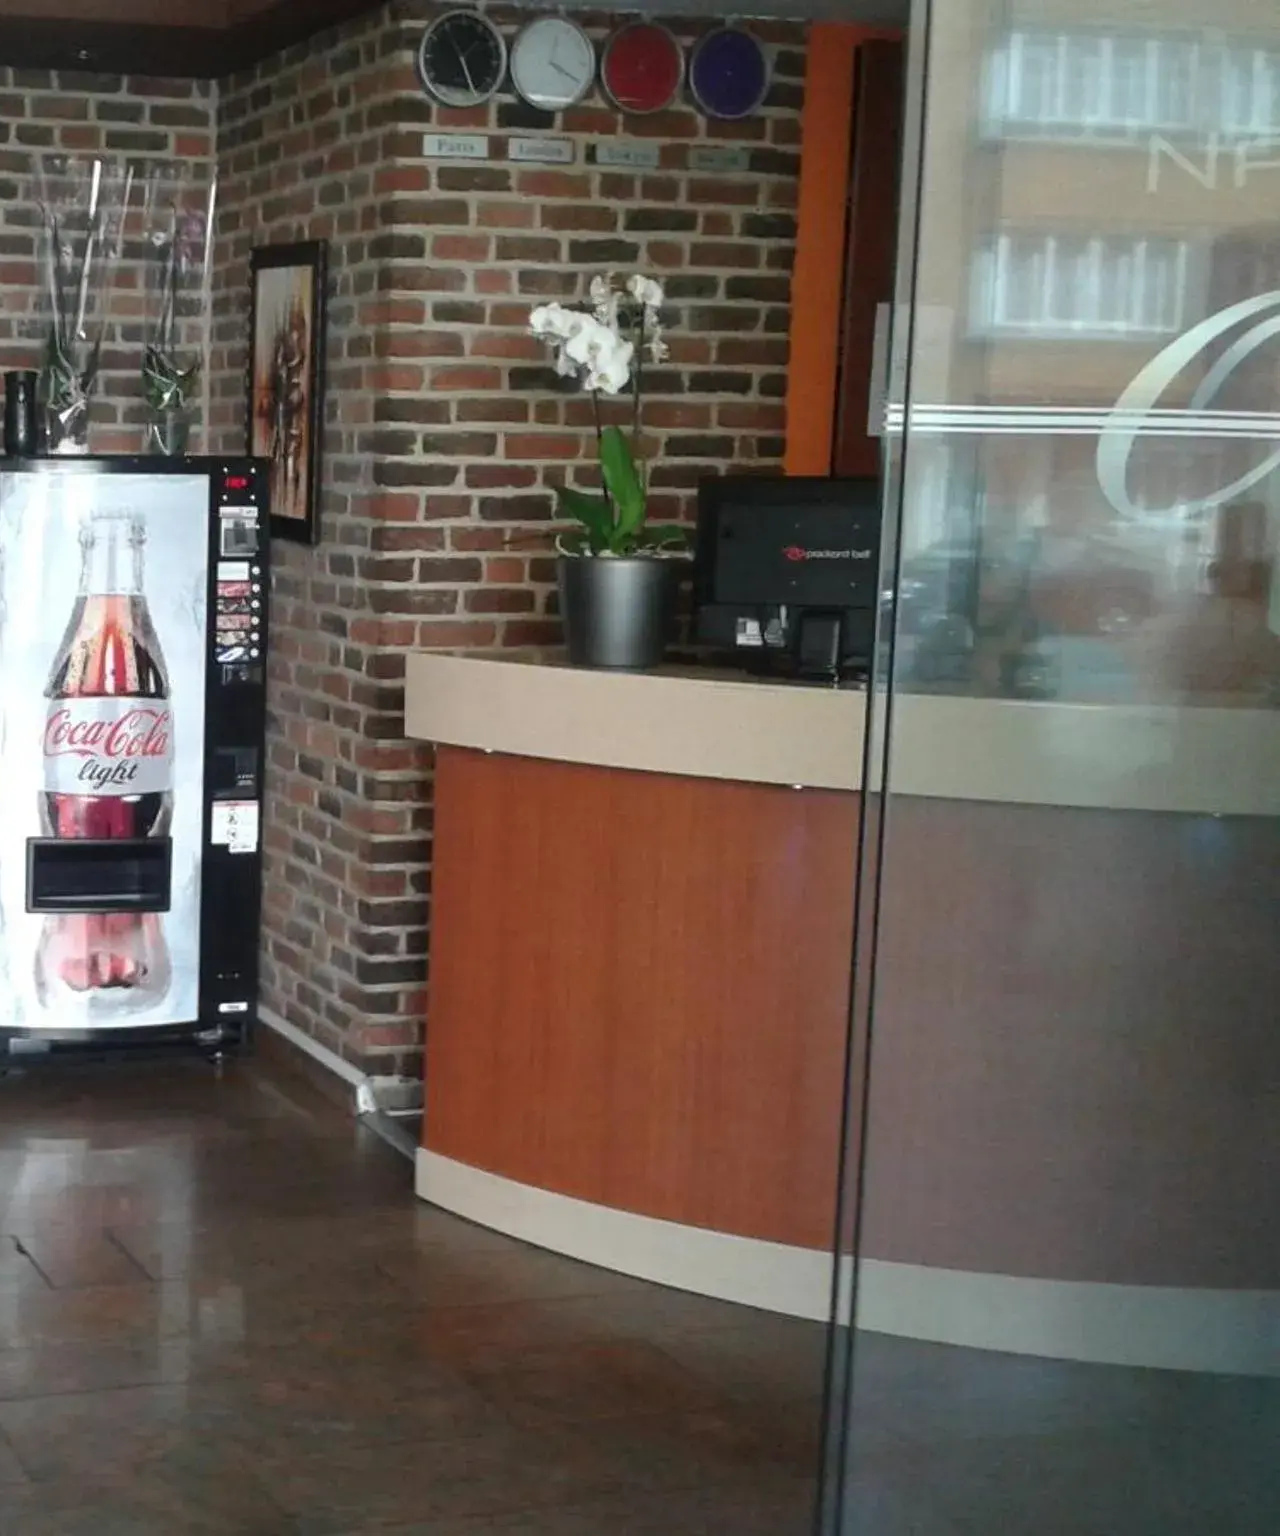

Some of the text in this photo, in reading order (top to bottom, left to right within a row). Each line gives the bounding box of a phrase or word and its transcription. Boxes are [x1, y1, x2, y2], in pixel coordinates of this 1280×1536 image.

[436, 138, 475, 154] Paris
[805, 549, 871, 559] packard bell
[43, 707, 171, 758] Coca-Cola
[77, 758, 139, 790] light
